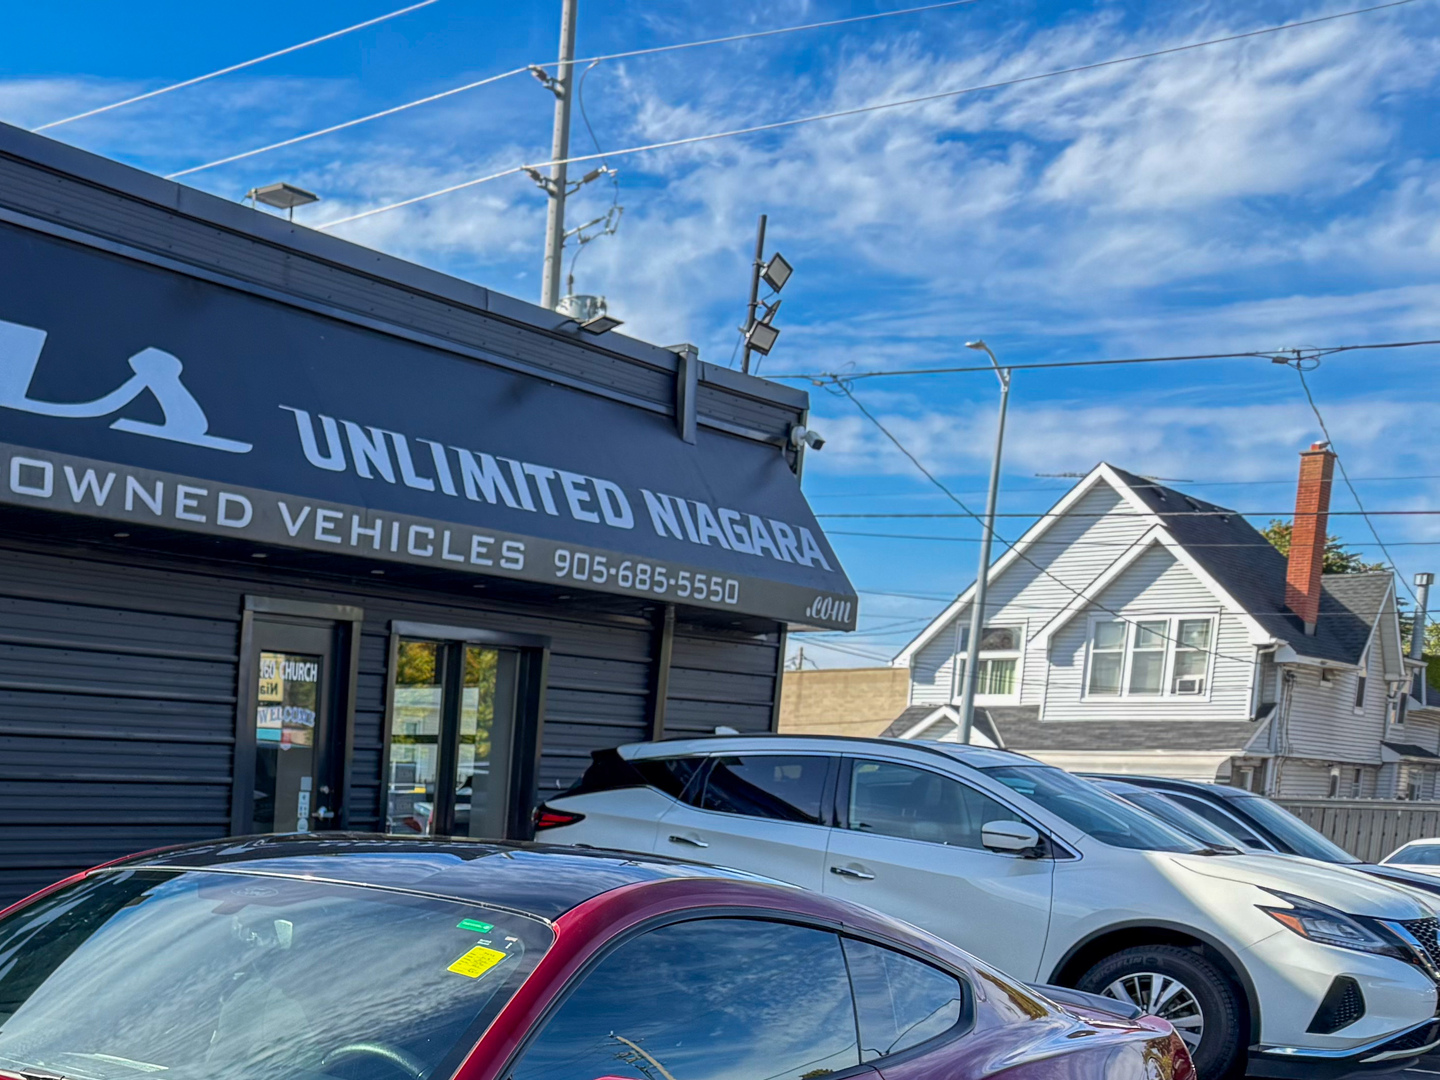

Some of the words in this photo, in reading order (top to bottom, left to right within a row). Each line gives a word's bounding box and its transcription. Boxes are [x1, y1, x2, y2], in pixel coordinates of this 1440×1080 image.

[278, 405, 634, 529] UNLIMITED
[640, 489, 836, 572] NIAGARA
[278, 501, 524, 571] VEHICLES
[554, 549, 739, 605] 905-685-5550
[806, 596, 851, 624] .com
[279, 661, 318, 682] CHURCH
[257, 705, 316, 727] WELCOME
